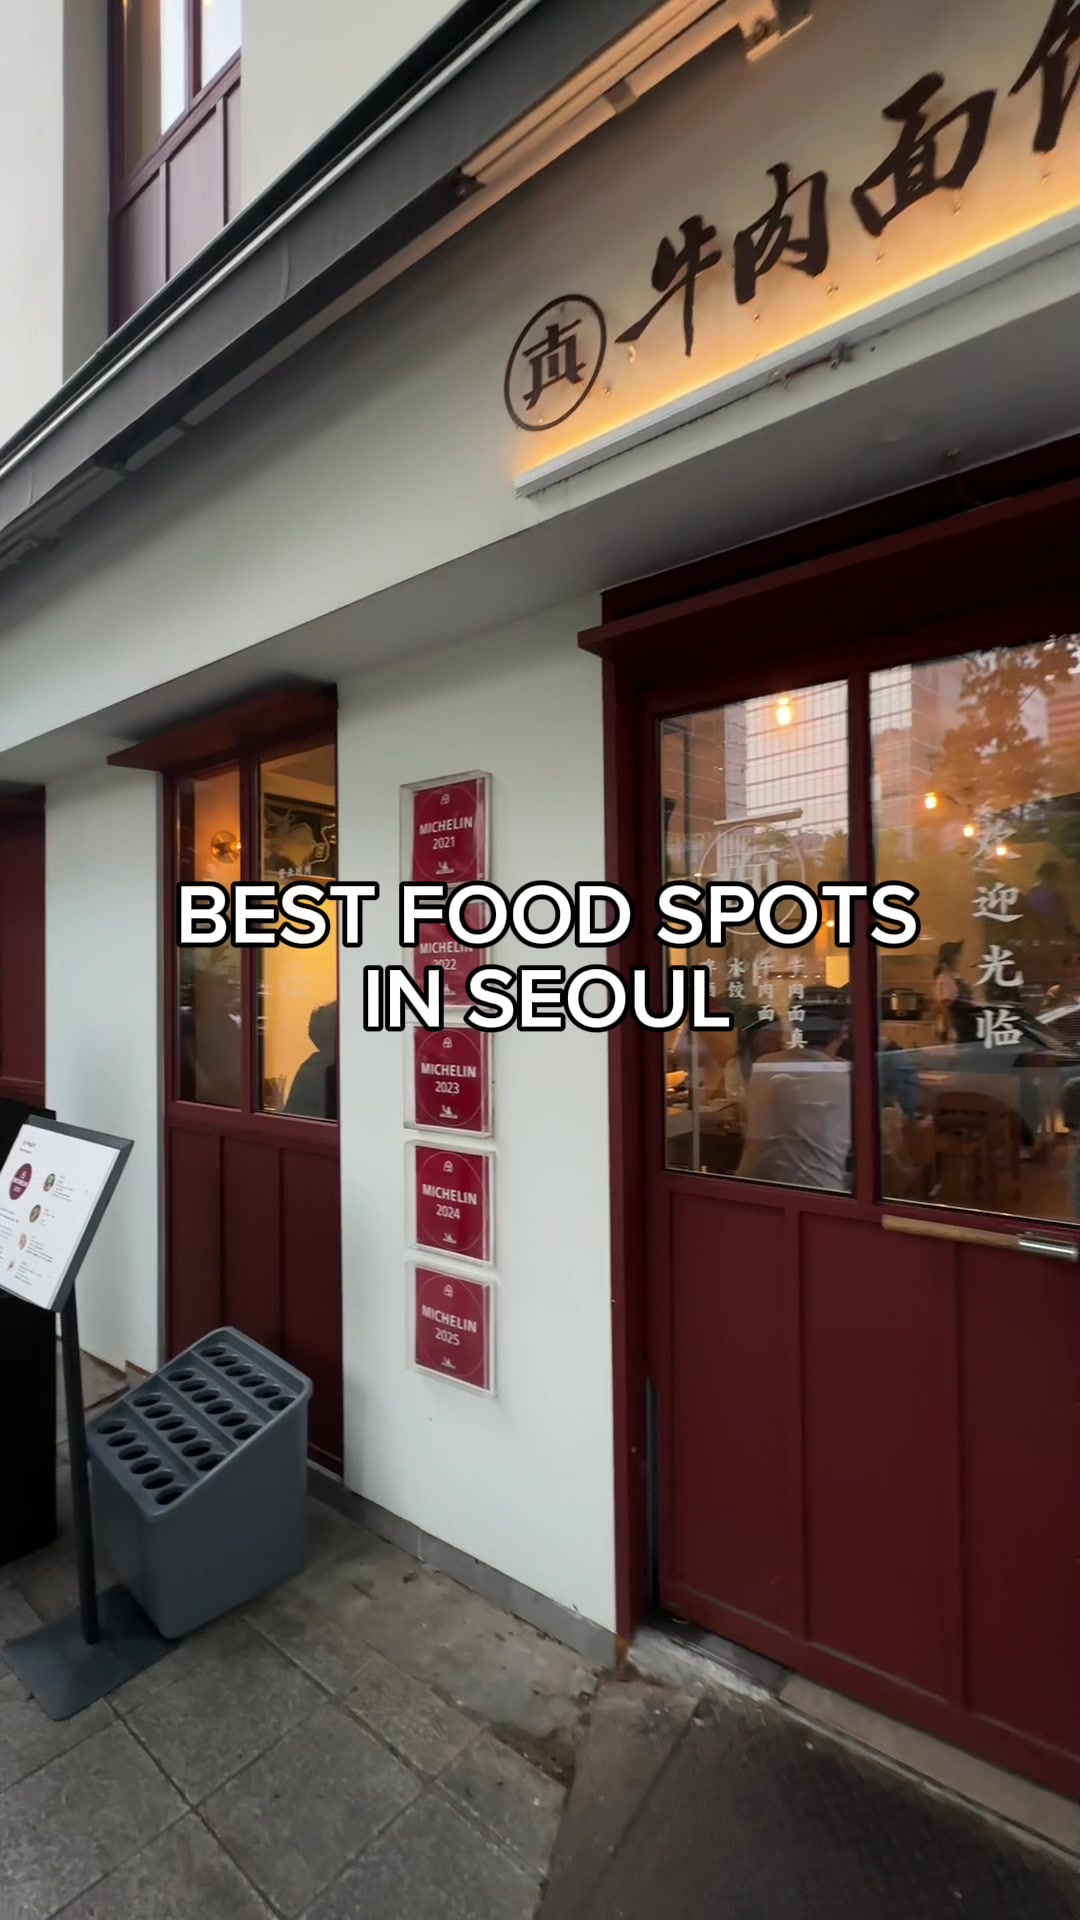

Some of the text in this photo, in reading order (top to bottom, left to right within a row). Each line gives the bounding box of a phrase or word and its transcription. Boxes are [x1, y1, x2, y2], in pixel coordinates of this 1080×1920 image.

[419, 816, 473, 836] MICHELIN
[432, 836, 455, 850] 2021
[421, 1062, 477, 1079] MICHELIN
[435, 1081, 460, 1095] 2023
[422, 1184, 477, 1205] MICHELIN
[435, 1203, 461, 1219] 2024
[421, 1304, 477, 1334] MICHELIN
[434, 1327, 460, 1346] 2025
